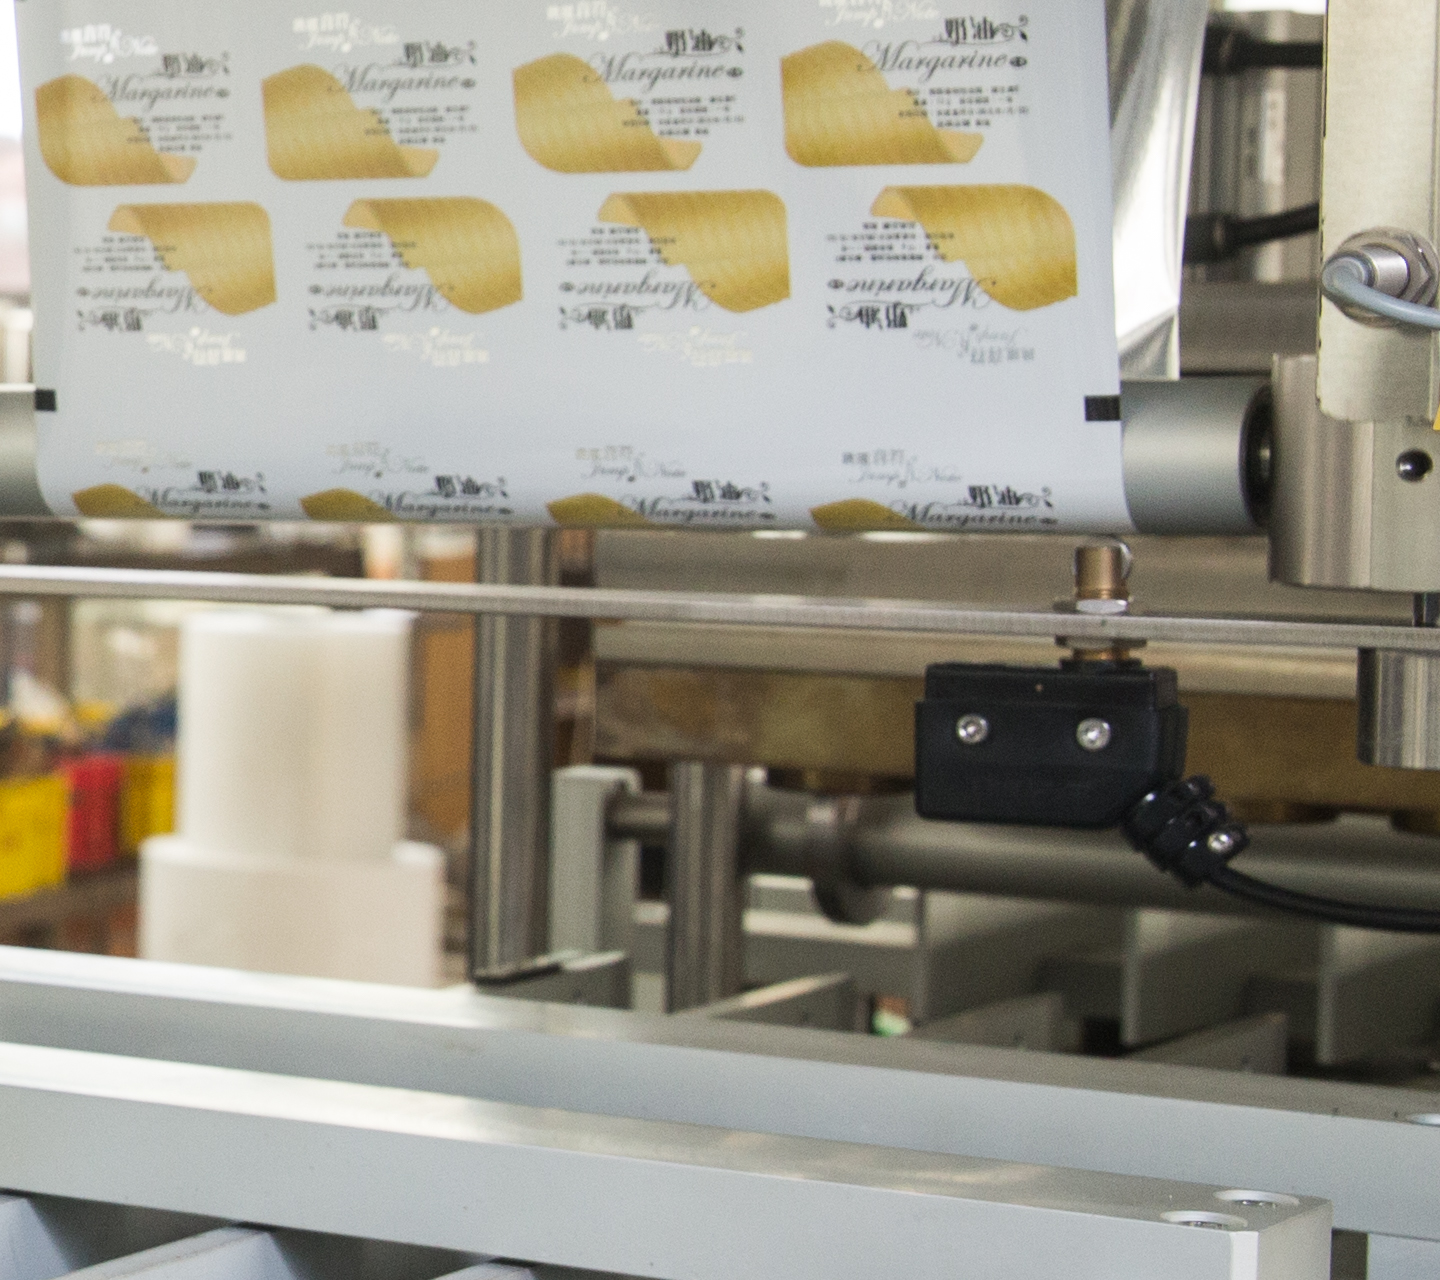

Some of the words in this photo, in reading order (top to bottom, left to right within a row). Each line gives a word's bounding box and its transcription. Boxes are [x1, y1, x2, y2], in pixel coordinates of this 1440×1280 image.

[582, 52, 724, 94] Margarine
[856, 40, 1009, 84] Margarine
[92, 73, 216, 112] Margarine
[328, 64, 460, 105] Margarine
[91, 275, 214, 314] Margarine
[324, 271, 455, 313] Margarine
[578, 268, 717, 313] Margarine
[848, 264, 999, 309] Margarine
[886, 499, 1039, 530] Margarine
